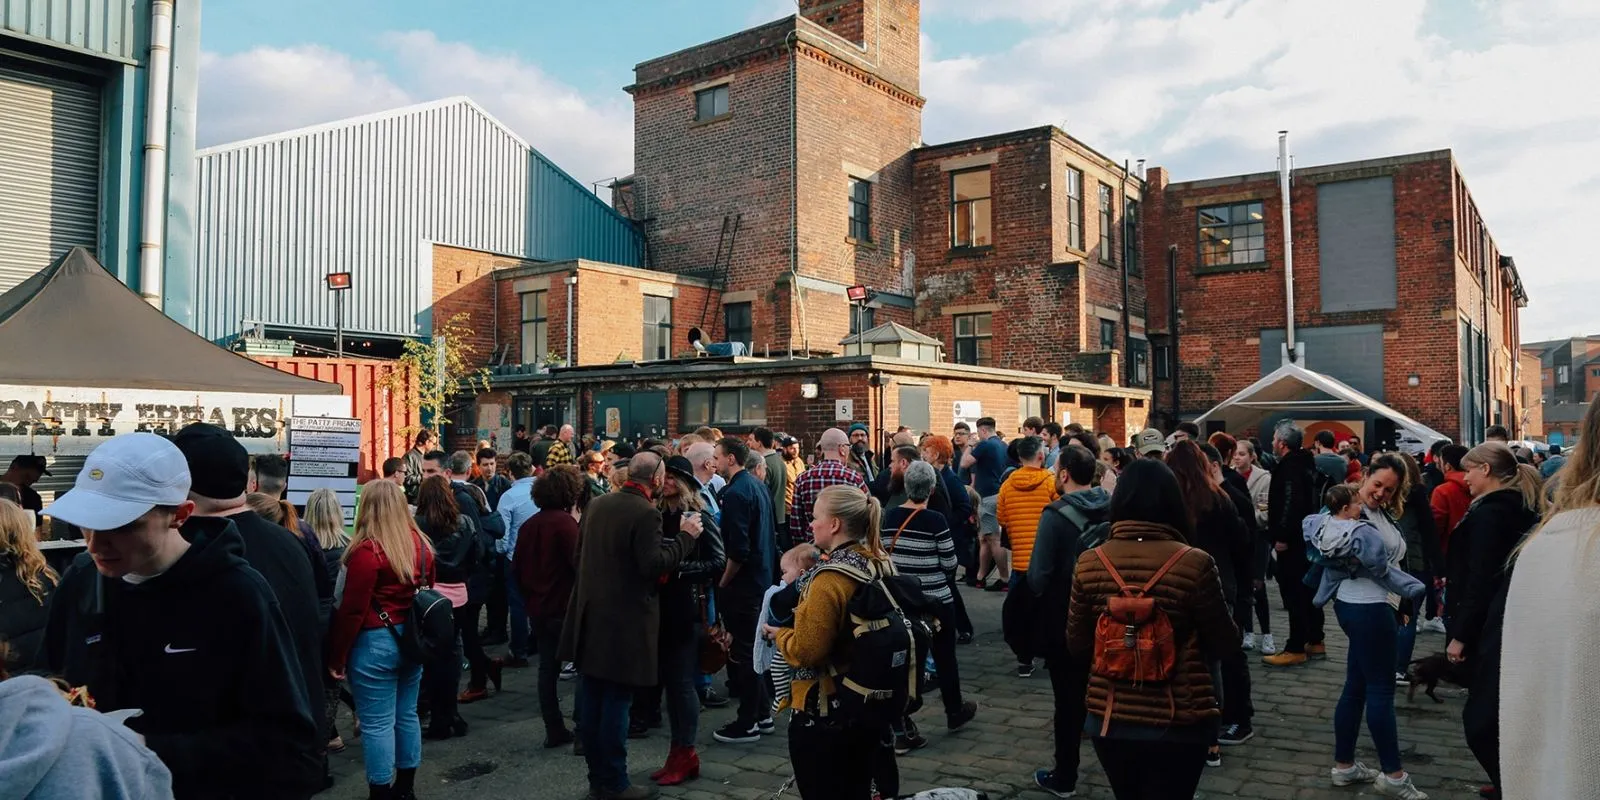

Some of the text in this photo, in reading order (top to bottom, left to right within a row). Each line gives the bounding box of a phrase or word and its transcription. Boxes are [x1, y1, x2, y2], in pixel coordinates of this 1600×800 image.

[842, 405, 847, 414] 5
[0, 400, 278, 438] PATTY FREAKS
[308, 418, 330, 426] PATTY
[333, 419, 360, 427] FREAKS
